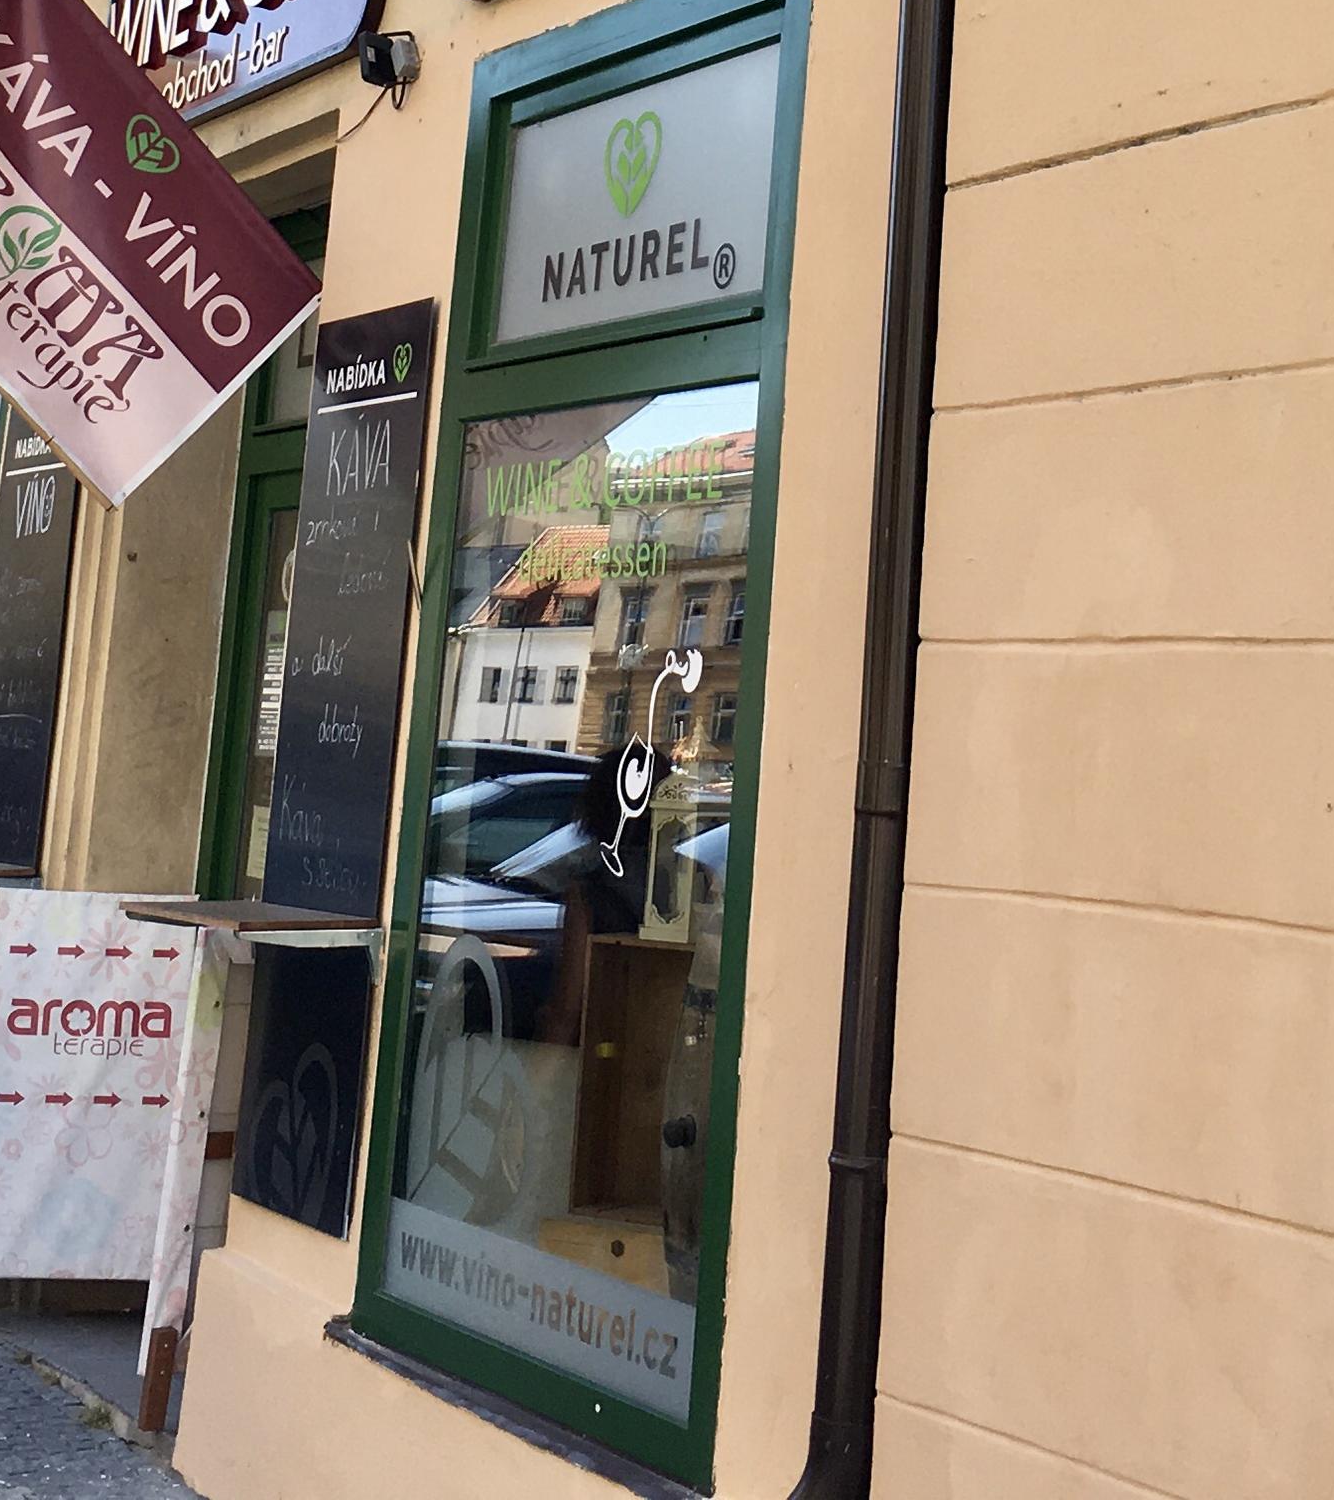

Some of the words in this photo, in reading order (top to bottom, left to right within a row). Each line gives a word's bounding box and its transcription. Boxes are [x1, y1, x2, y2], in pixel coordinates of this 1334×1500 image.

[123, 190, 252, 348] VÍNO
[325, 353, 387, 395] NABÍDKA
[325, 413, 392, 497] KÁVA
[486, 457, 563, 518] WINE
[602, 440, 728, 508] COFFEE
[15, 472, 57, 540] VÍNO
[6, 997, 173, 1040] aroma
[53, 1031, 145, 1061] terapie
